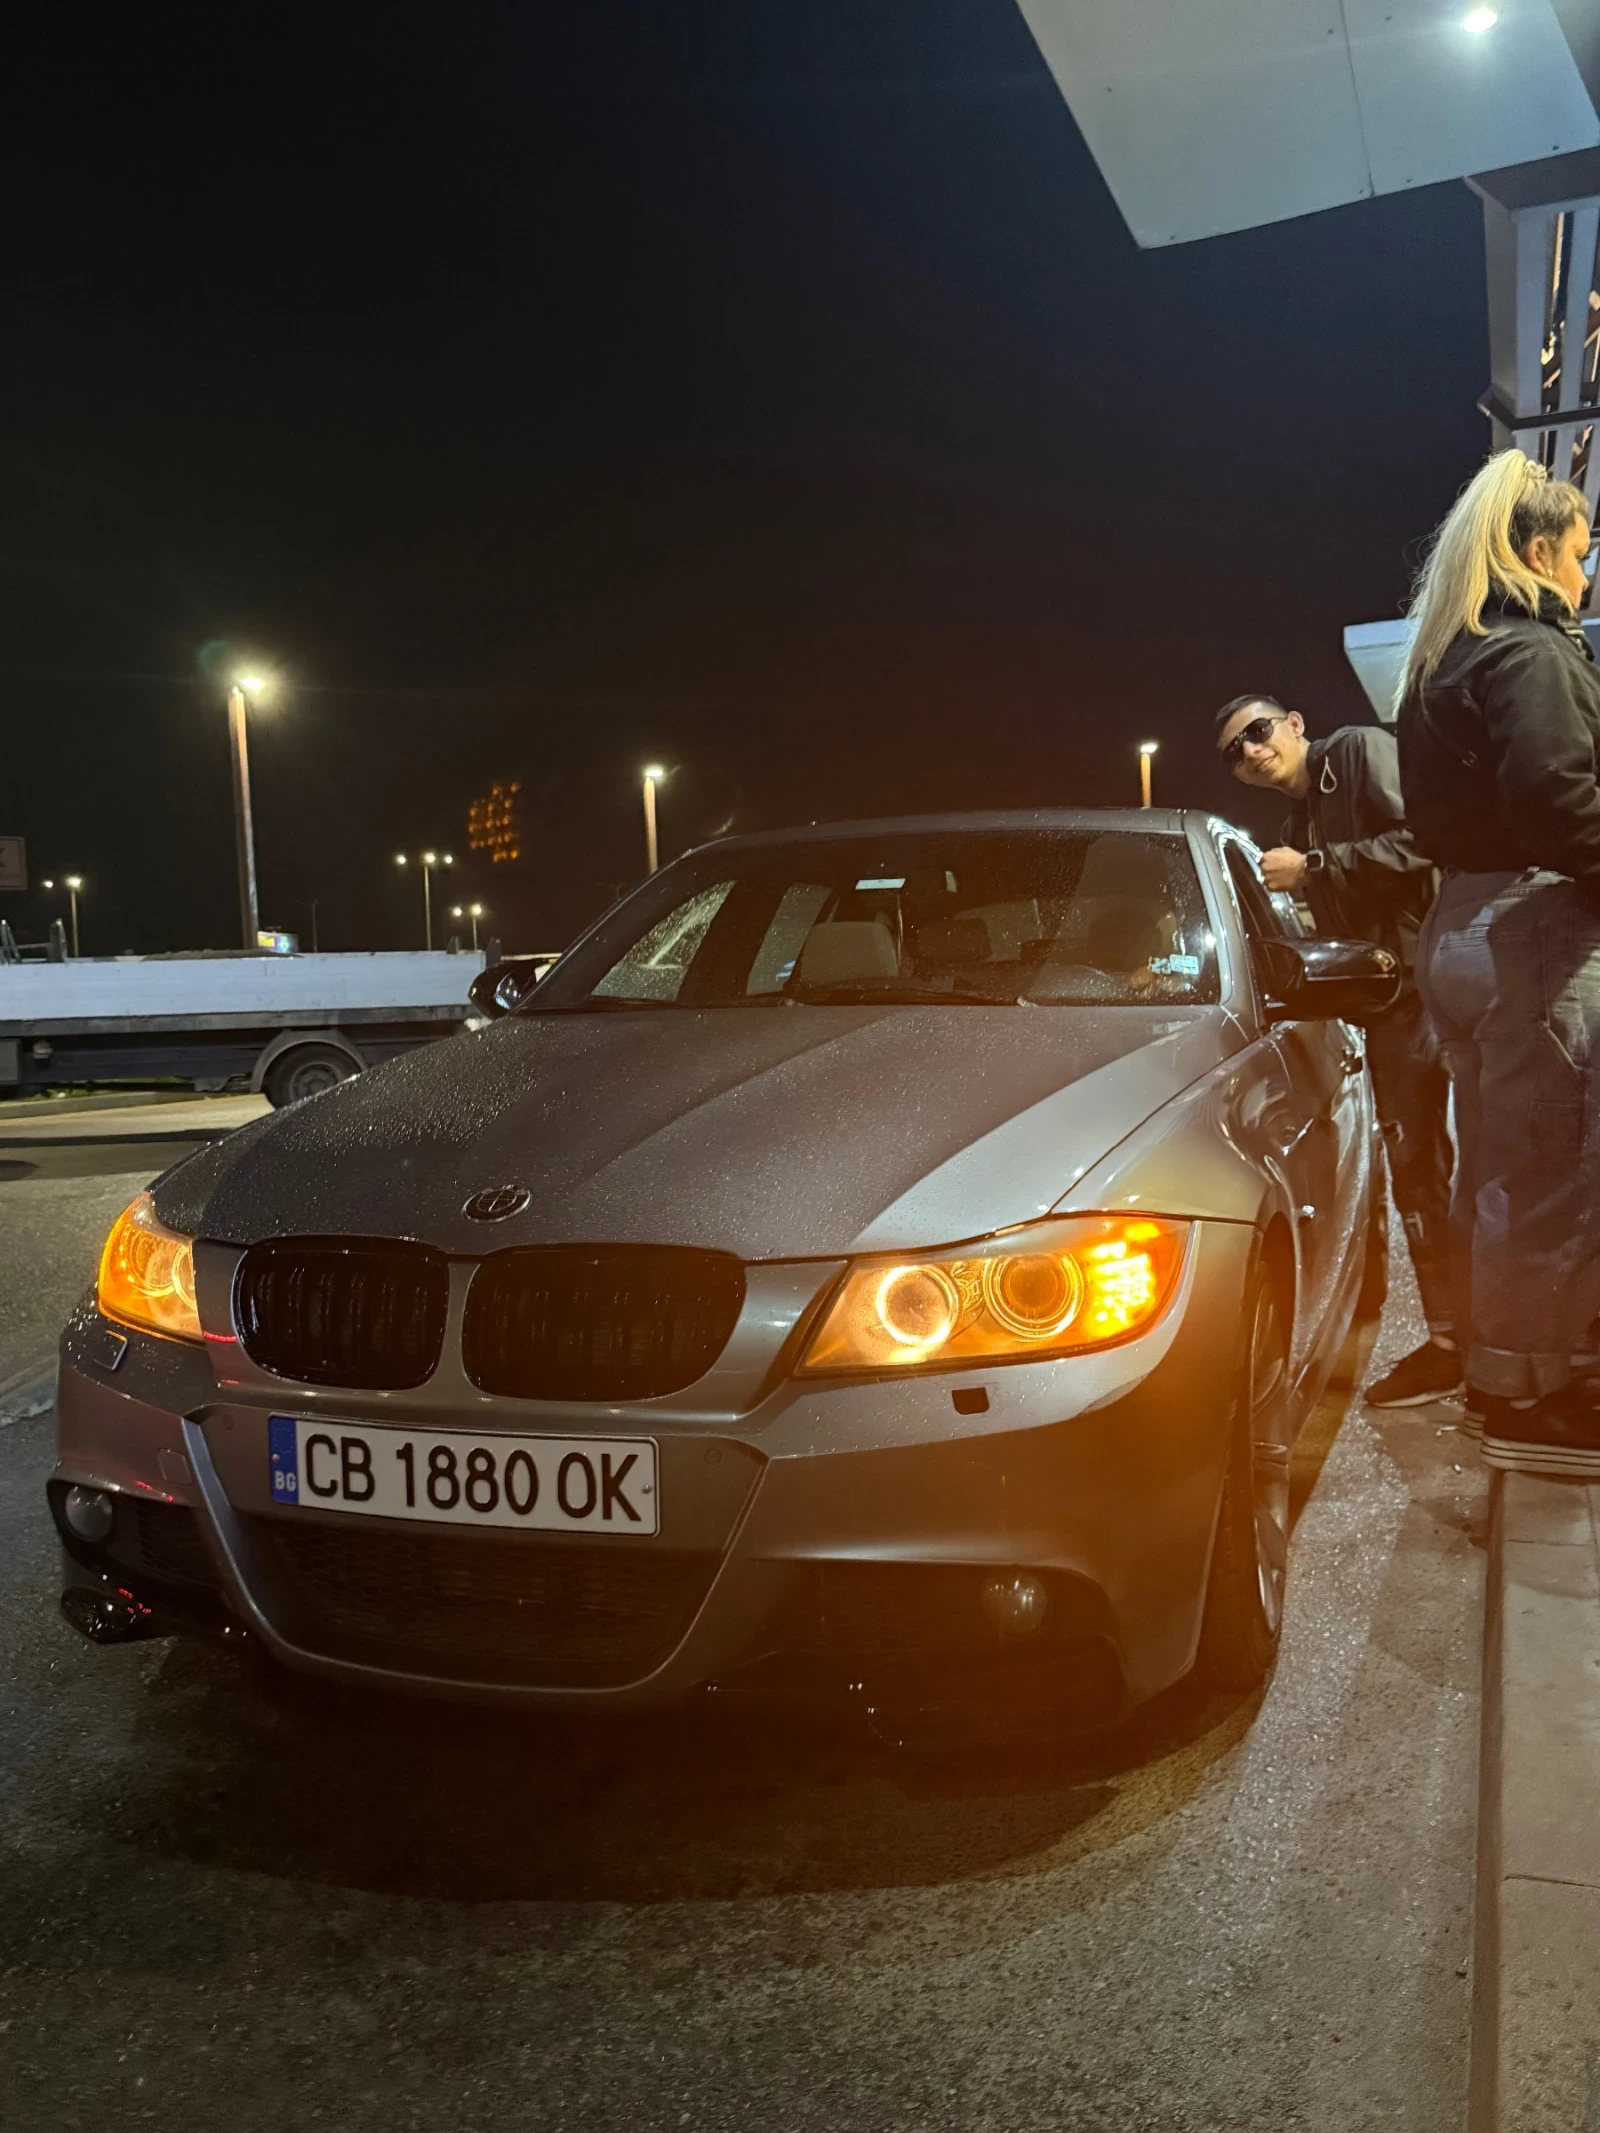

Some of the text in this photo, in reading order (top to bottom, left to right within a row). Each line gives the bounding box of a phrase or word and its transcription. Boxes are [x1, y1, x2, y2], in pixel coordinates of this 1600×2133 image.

[275, 1470, 297, 1492] BG
[305, 1433, 642, 1521] CB 1880 OK
